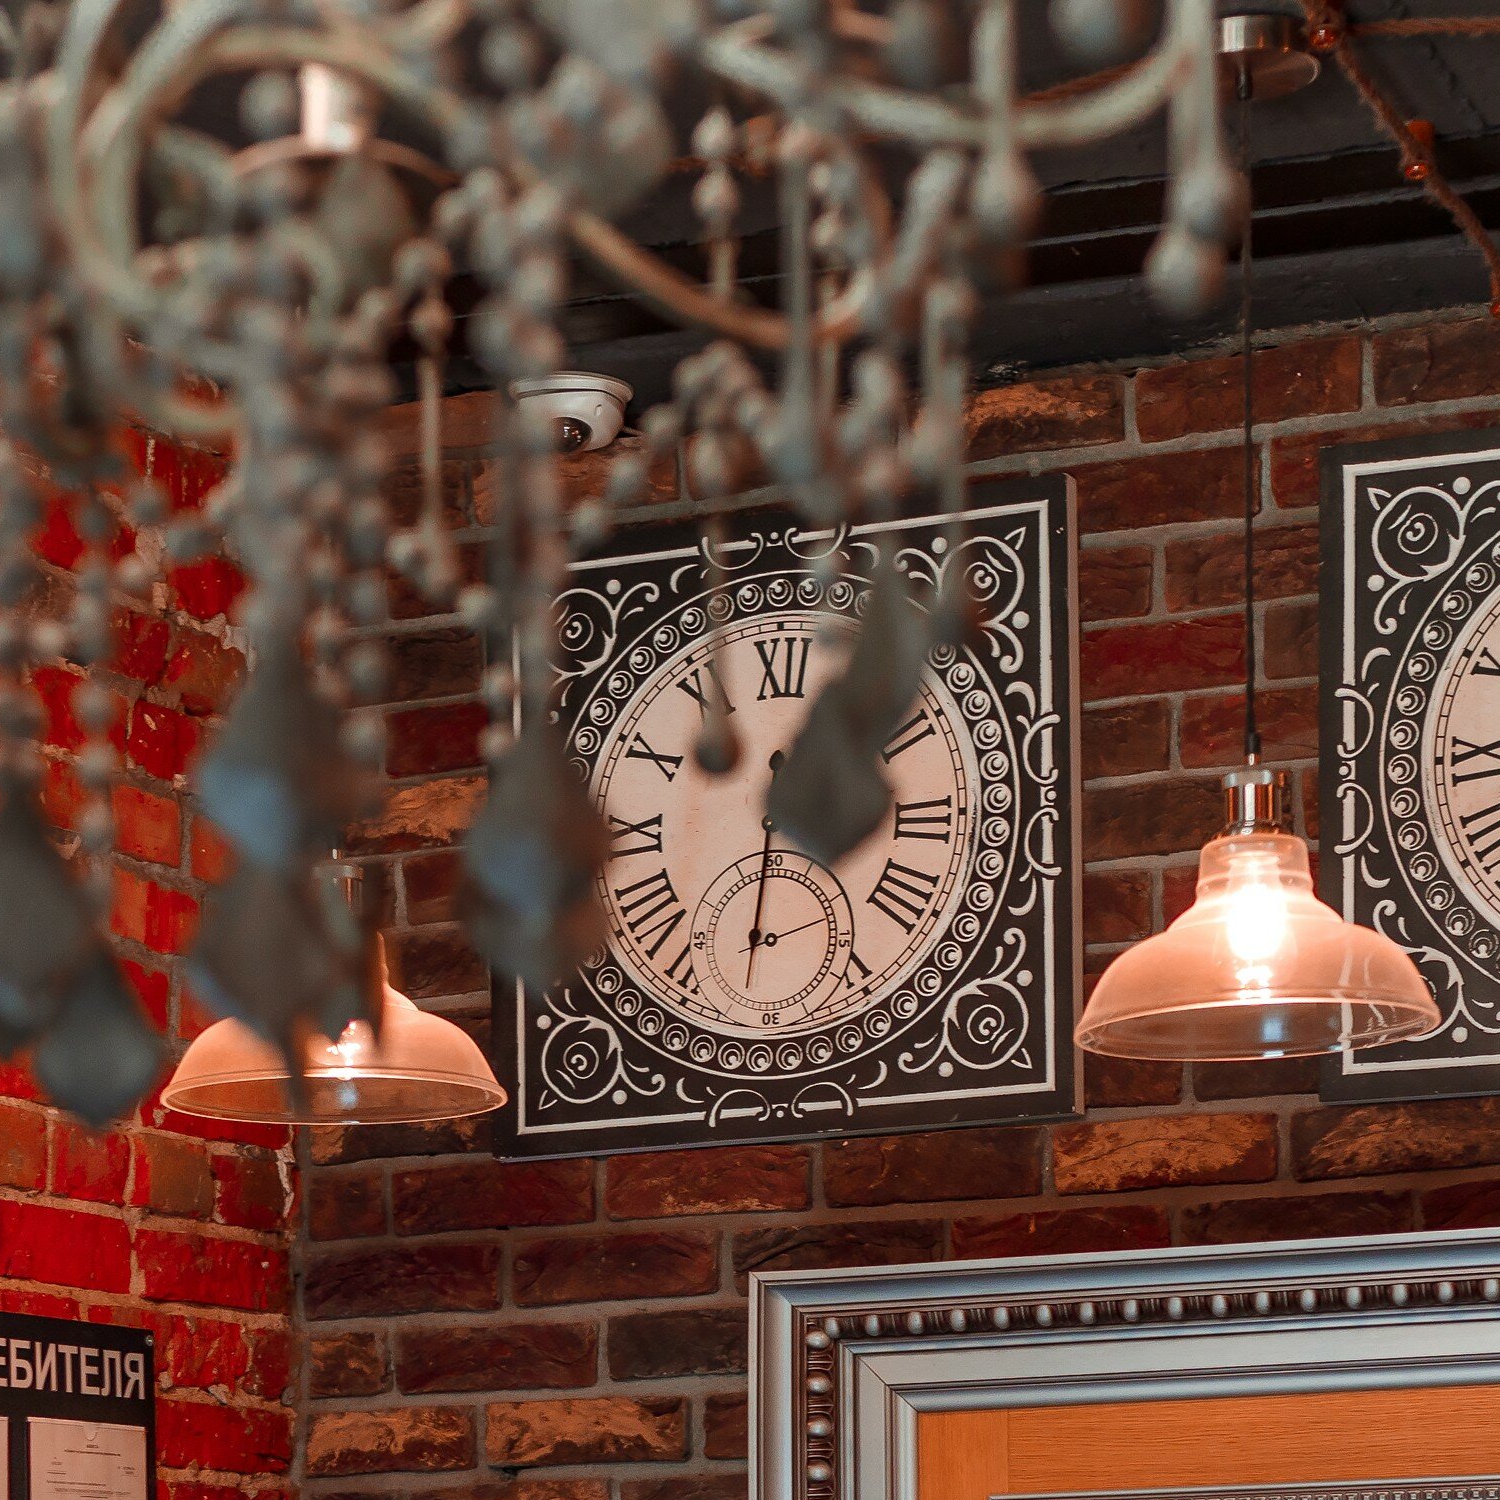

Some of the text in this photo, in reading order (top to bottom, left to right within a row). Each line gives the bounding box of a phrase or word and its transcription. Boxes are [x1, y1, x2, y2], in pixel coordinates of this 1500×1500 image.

[754, 637, 813, 701] XII
[625, 731, 684, 783] X
[880, 708, 937, 765] II
[608, 812, 664, 860] IX
[896, 795, 952, 844] III
[613, 867, 688, 961] VIII
[866, 857, 942, 936] IIII
[693, 931, 707, 951] 45
[838, 929, 851, 948] 15
[761, 1011, 780, 1026] 30
